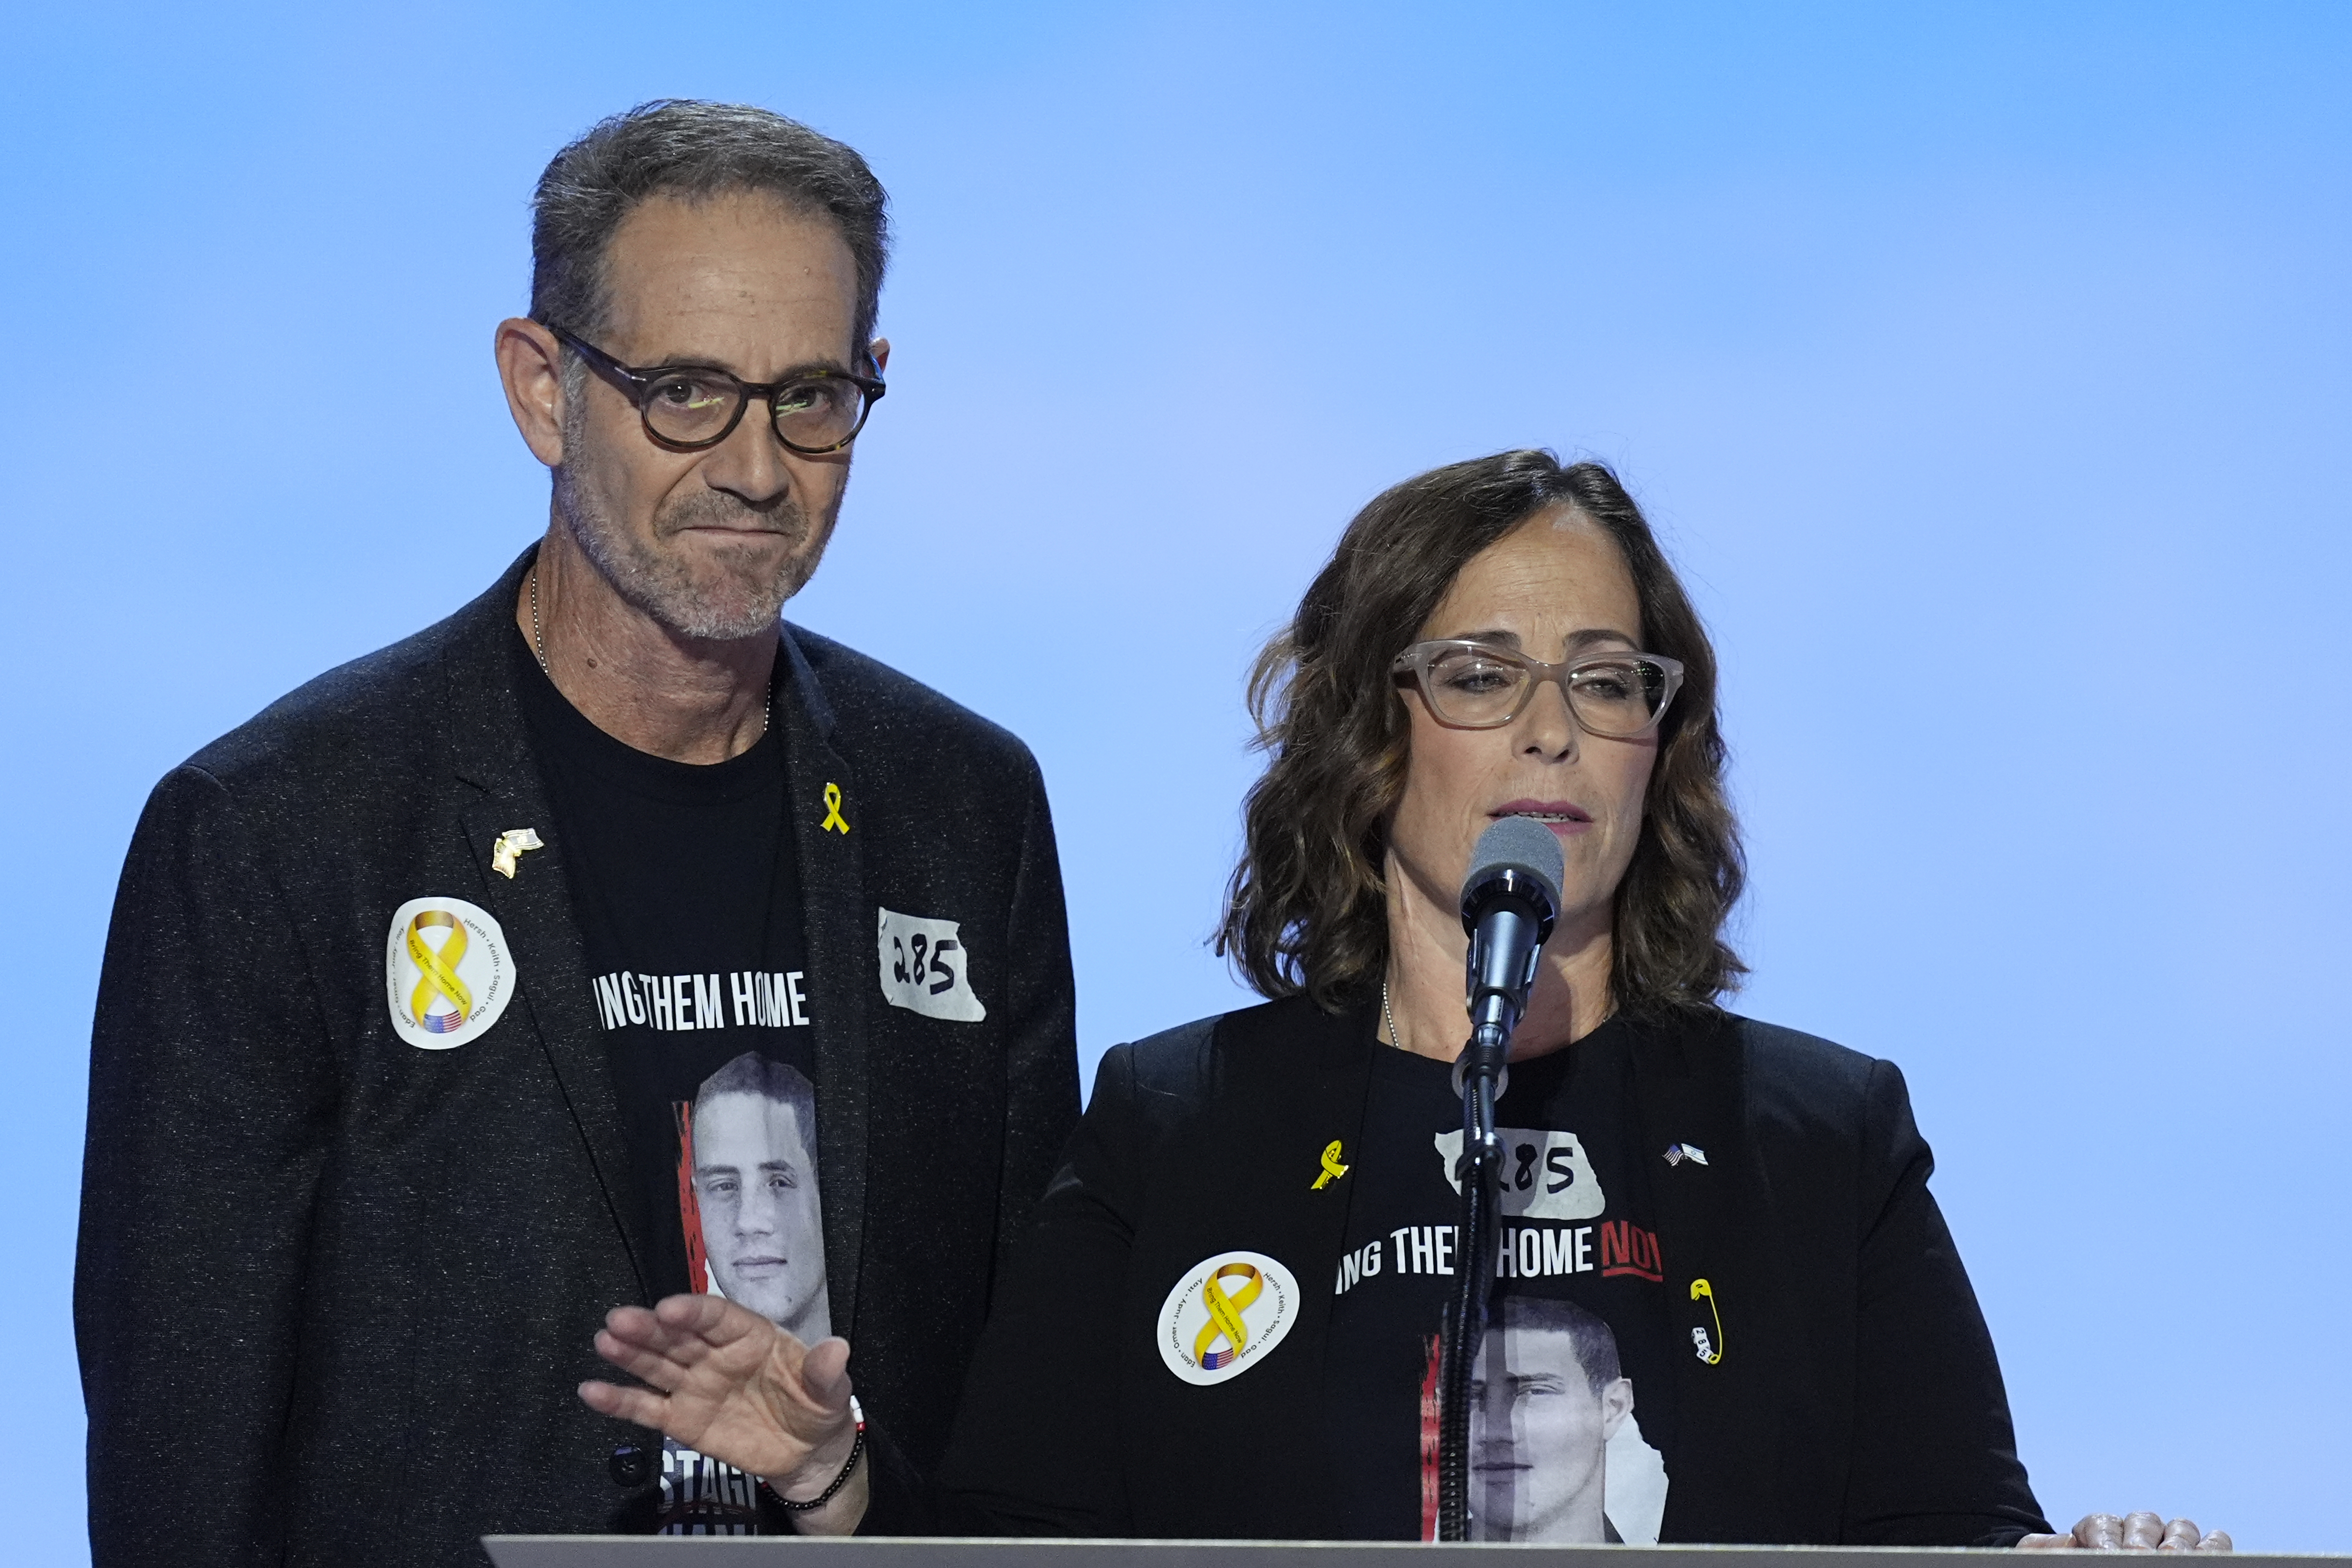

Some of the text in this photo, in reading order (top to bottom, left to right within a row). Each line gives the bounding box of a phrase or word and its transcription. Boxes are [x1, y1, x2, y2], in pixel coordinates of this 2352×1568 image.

[409, 939, 467, 1005] Bring Them Home Now
[464, 919, 501, 1022] Hersh Keith Sagui Gad
[893, 933, 958, 995] 285
[399, 1009, 416, 1028] Edan
[638, 973, 724, 1031] THEM
[730, 970, 810, 1028] HOME
[1499, 1143, 1573, 1194] 85
[1390, 1225, 1459, 1275] THE
[1496, 1226, 1593, 1278] HOME
[1172, 1277, 1203, 1368] Edan Omer Judy Itay
[1207, 1286, 1242, 1344] Bring Them Home Now
[1240, 1272, 1286, 1359] Hersh Keith Sagui Gad
